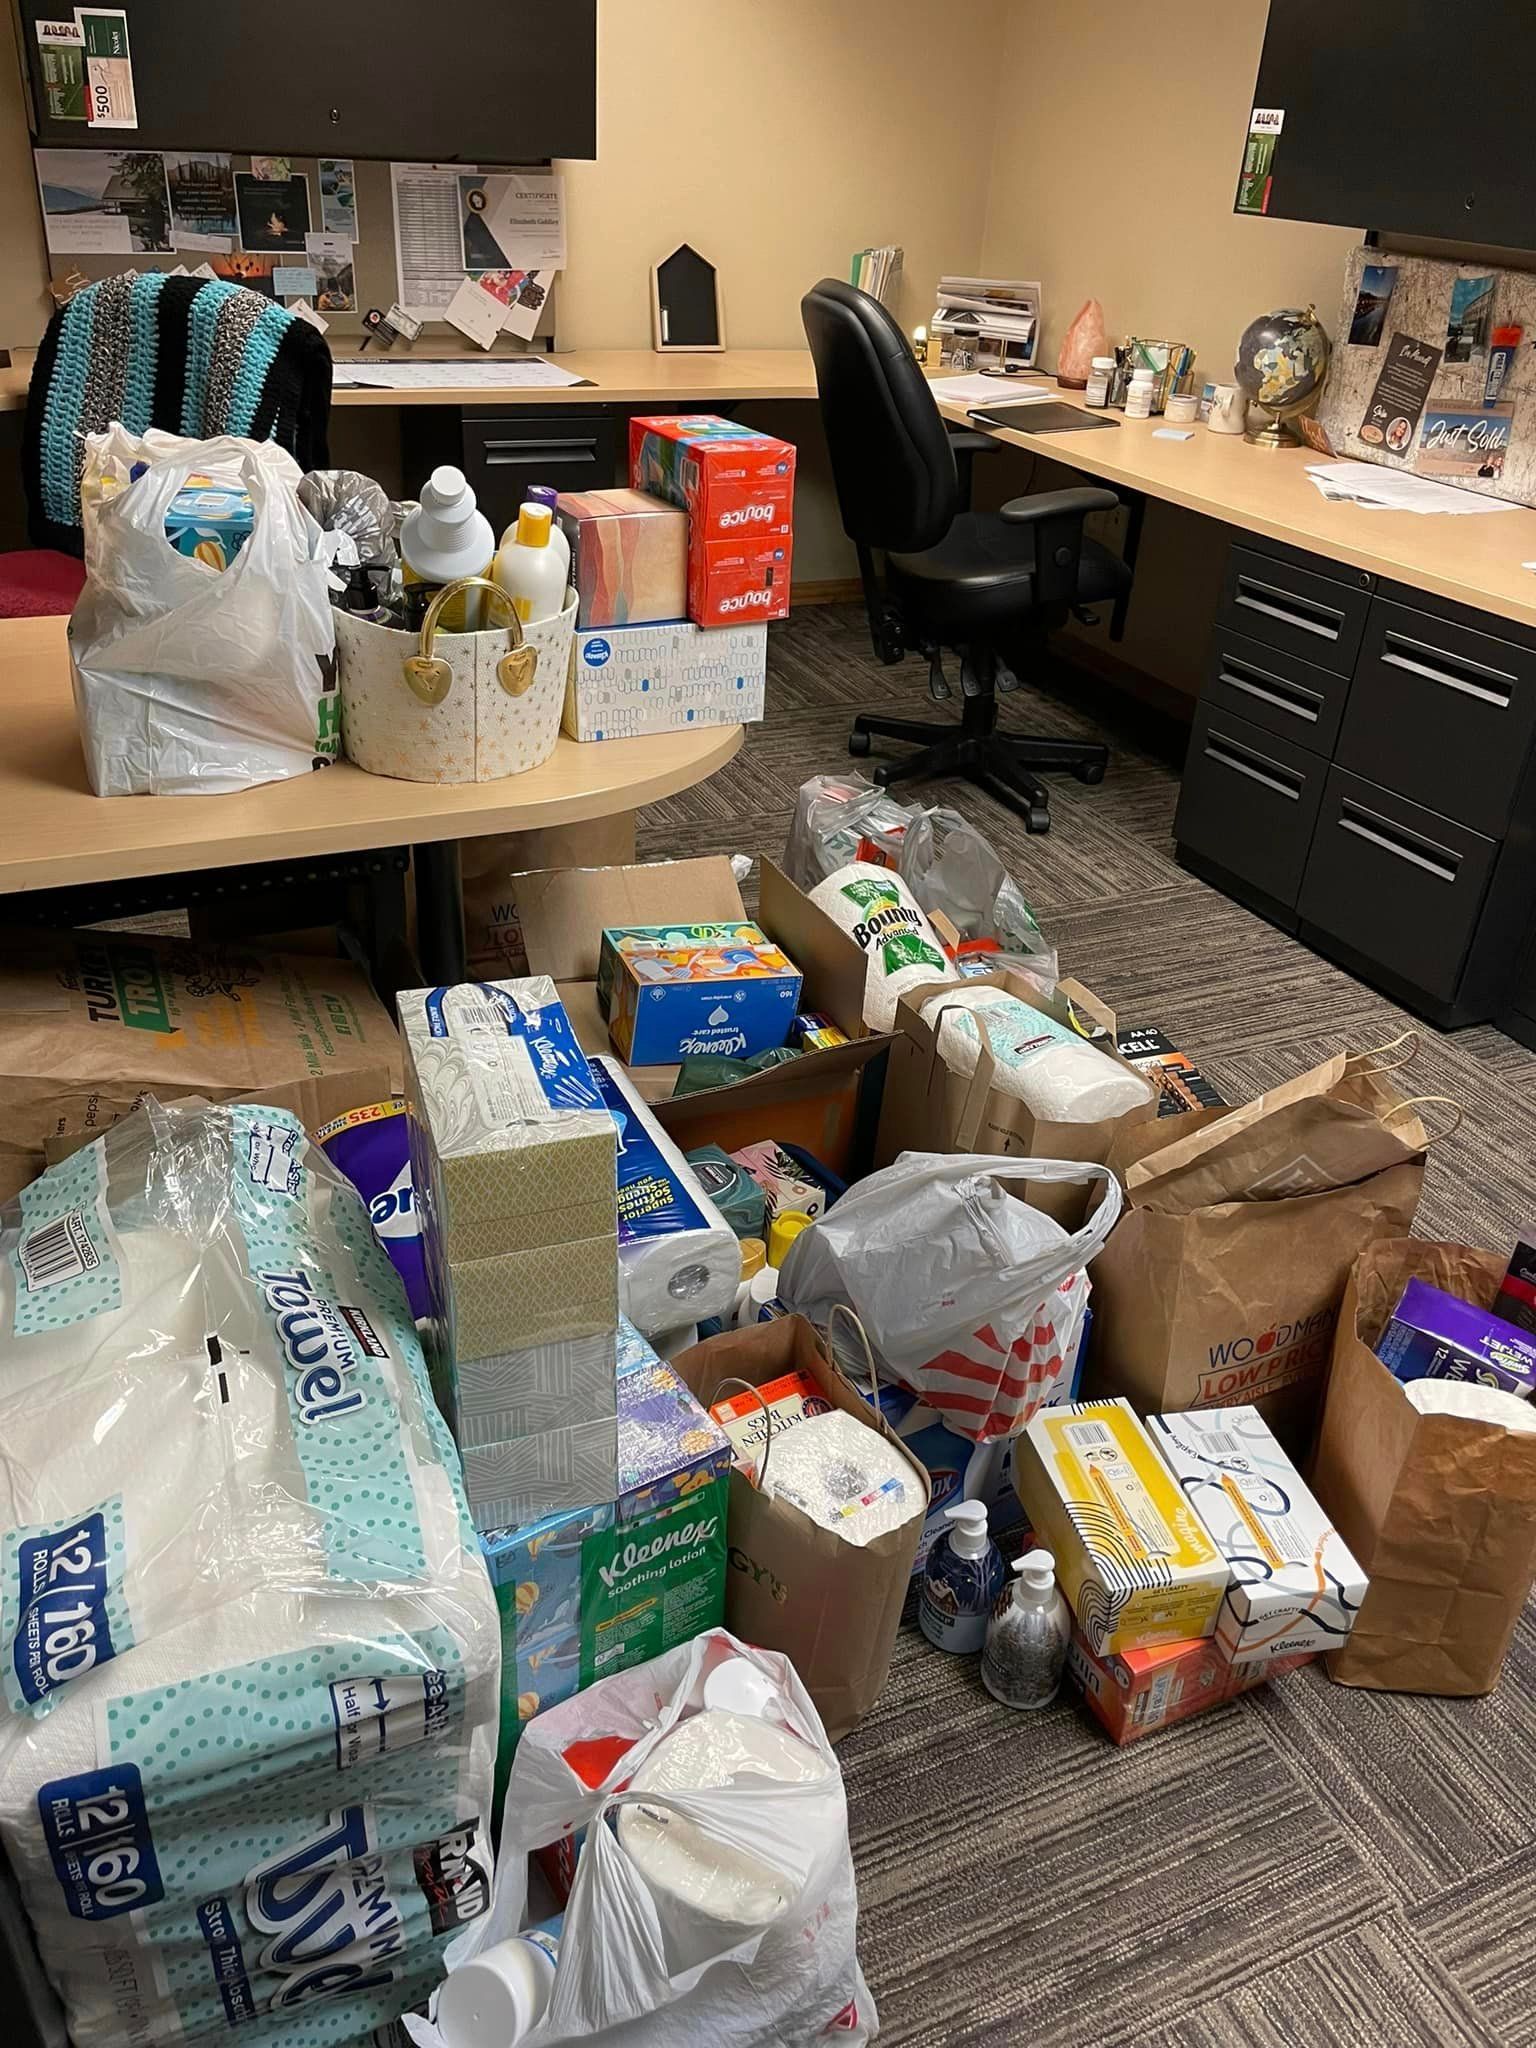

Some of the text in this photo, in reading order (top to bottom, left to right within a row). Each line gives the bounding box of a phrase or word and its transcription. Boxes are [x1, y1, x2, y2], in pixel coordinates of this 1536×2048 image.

[95, 86, 110, 118] $500
[515, 192, 558, 200] CERTIFICATE
[1427, 420, 1506, 453] Just Sold
[720, 504, 775, 528] bounce
[719, 589, 772, 613] bounce
[852, 907, 922, 950] Bounty
[780, 990, 793, 998] 160
[679, 1033, 747, 1056] Kleenex
[709, 1027, 739, 1036] trusted
[1131, 1031, 1145, 1039] AA
[349, 1106, 381, 1123] 235
[617, 1183, 658, 1204] Streng
[618, 1186, 671, 1213] Softnes
[623, 1195, 674, 1221] Superior
[77, 1234, 97, 1267] 1742835
[262, 1270, 363, 1420] Towel
[315, 1299, 355, 1370] PREMIUM
[348, 1308, 386, 1357] KIRKLAND
[1435, 1346, 1450, 1361] 12
[1480, 1336, 1534, 1367] WETJET
[1490, 1351, 1531, 1375] Swiffer
[1204, 1363, 1264, 1400] LOW
[742, 1414, 803, 1448] KITCHEN
[1172, 1506, 1212, 1563] Imagine
[599, 1516, 719, 1588] Kleenex
[32, 1549, 49, 1595] ROLLS
[608, 1546, 707, 1599] soothing lotion
[45, 1529, 97, 1682] 12 160
[27, 1607, 41, 1650] SHEETS
[1270, 1638, 1316, 1653] Kleenex
[32, 1664, 50, 1697] ROL
[343, 1686, 361, 1718] Half
[52, 1798, 76, 1838] ROLLS
[76, 1785, 130, 1832] 12
[84, 1836, 147, 1907] 160
